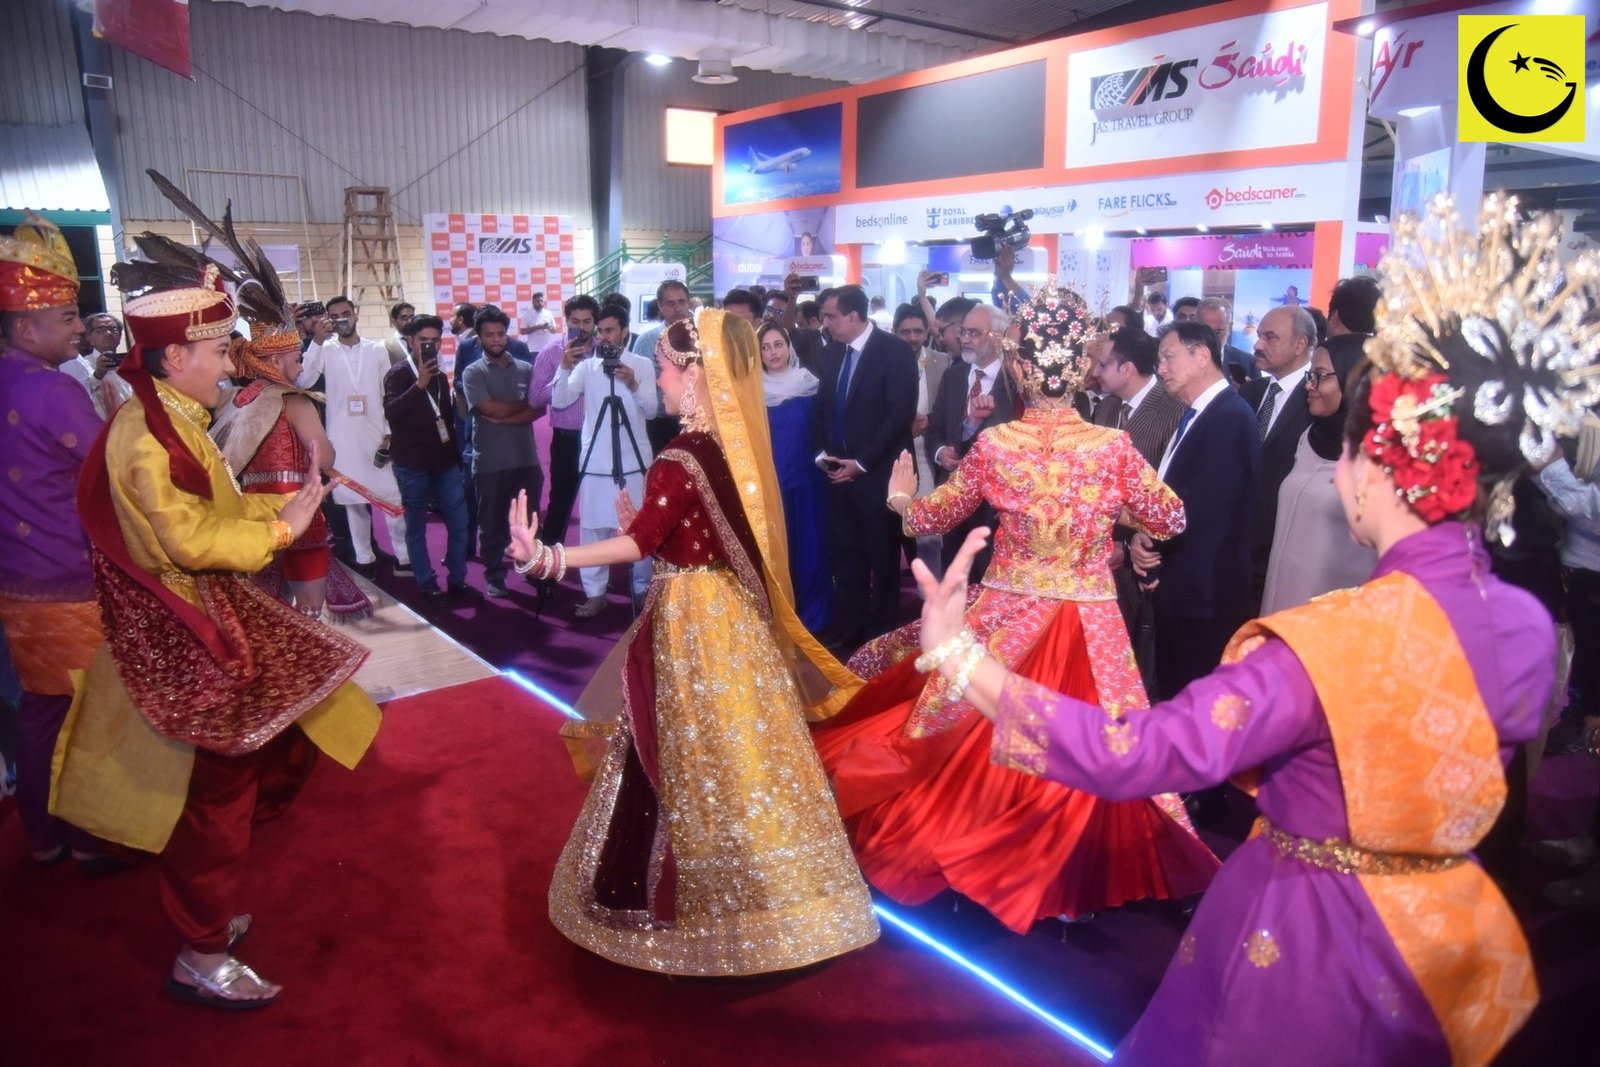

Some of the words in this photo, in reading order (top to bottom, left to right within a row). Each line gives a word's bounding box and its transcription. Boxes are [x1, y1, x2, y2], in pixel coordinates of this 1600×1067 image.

[1110, 115, 1152, 131] TRAVEL
[1153, 107, 1194, 125] GROUP
[1097, 195, 1128, 211] FARE
[1130, 192, 1172, 209] FLICKS
[942, 207, 967, 216] ROYAL
[1033, 205, 1065, 217] alaysia
[855, 213, 909, 229] bedsonline
[942, 216, 976, 226] CARIBBE
